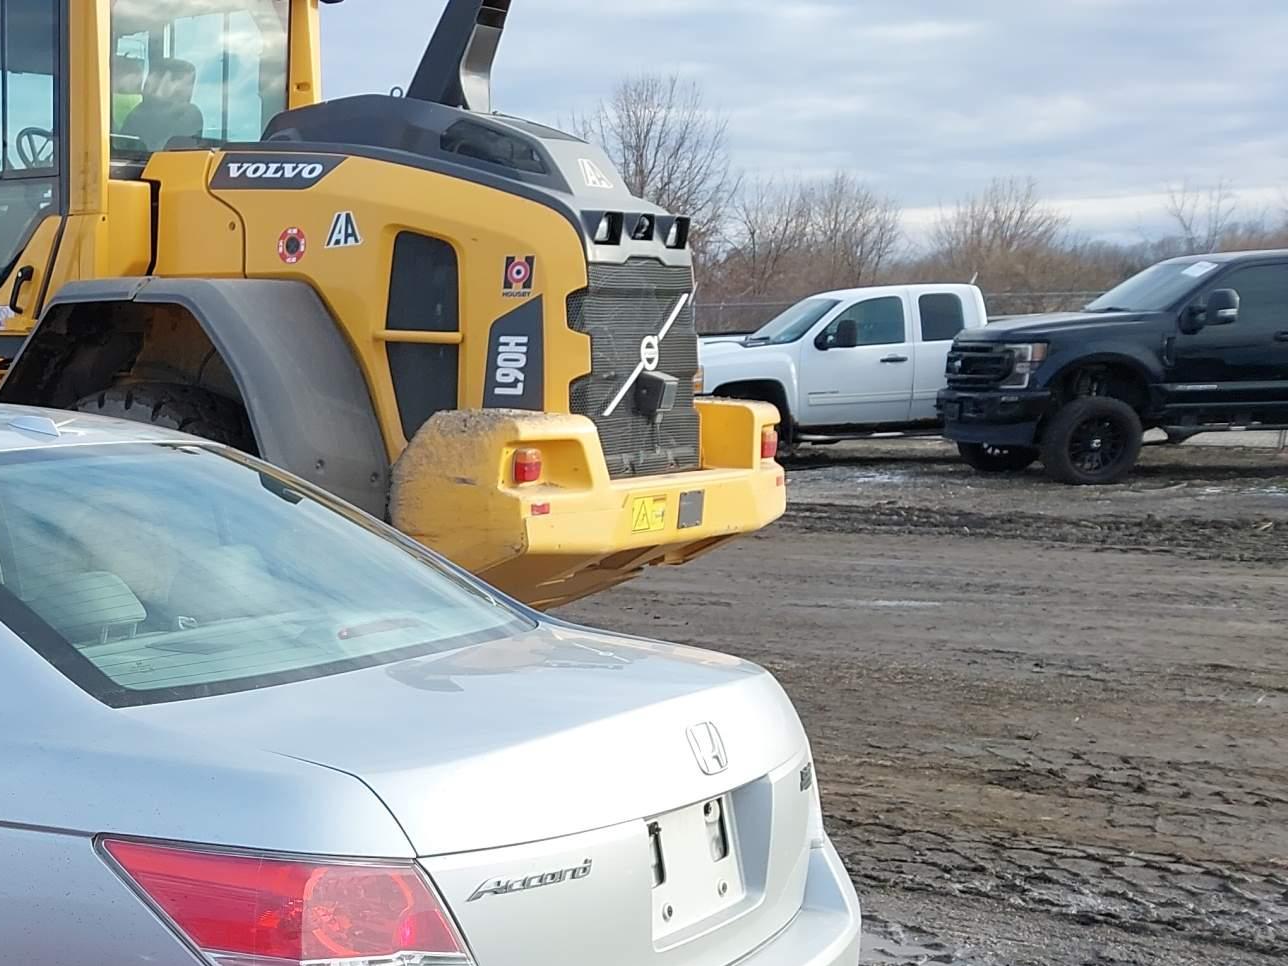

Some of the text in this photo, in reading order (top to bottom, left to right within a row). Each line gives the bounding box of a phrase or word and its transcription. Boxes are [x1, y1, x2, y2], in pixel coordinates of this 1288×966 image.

[227, 162, 324, 179] VOLVO
[325, 211, 361, 248] IAA
[493, 335, 530, 396] L90H
[465, 858, 593, 902] Accord
